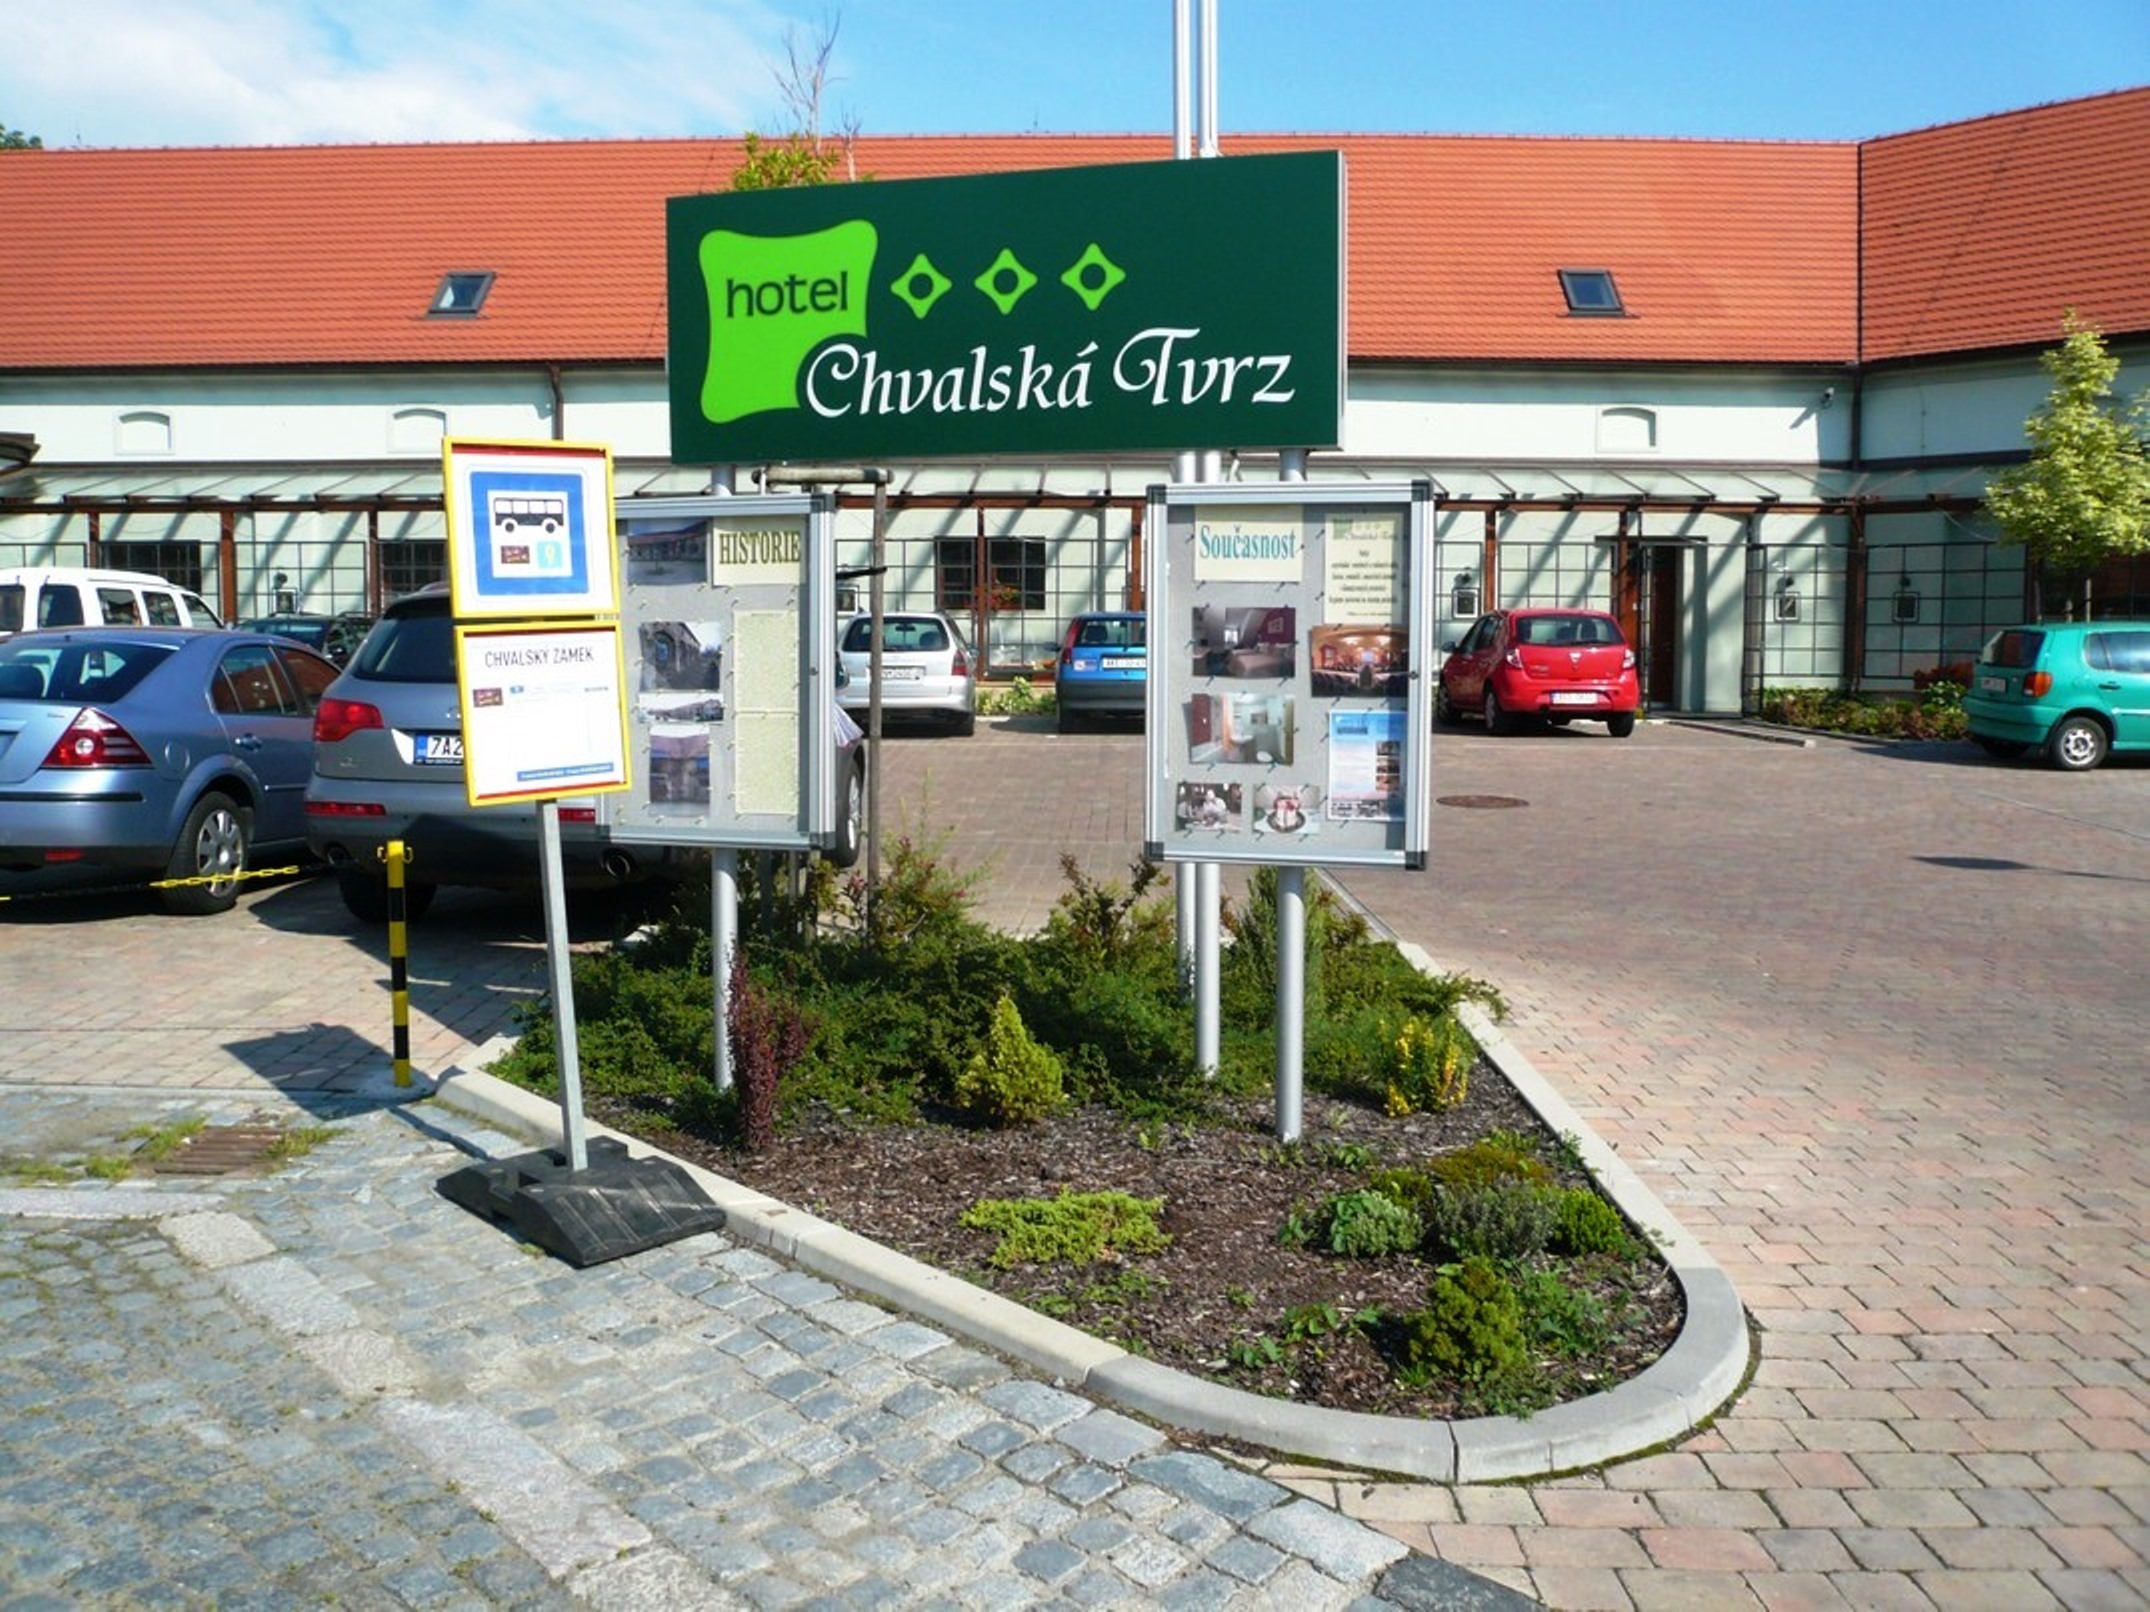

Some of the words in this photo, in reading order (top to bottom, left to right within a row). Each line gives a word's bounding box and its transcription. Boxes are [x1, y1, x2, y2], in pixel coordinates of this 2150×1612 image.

[726, 270, 849, 319] hotel
[806, 341, 1099, 418] Chvalská
[1112, 326, 1296, 406] Tvrz
[719, 530, 801, 565] HISTORIE
[1199, 523, 1296, 560] Současnost
